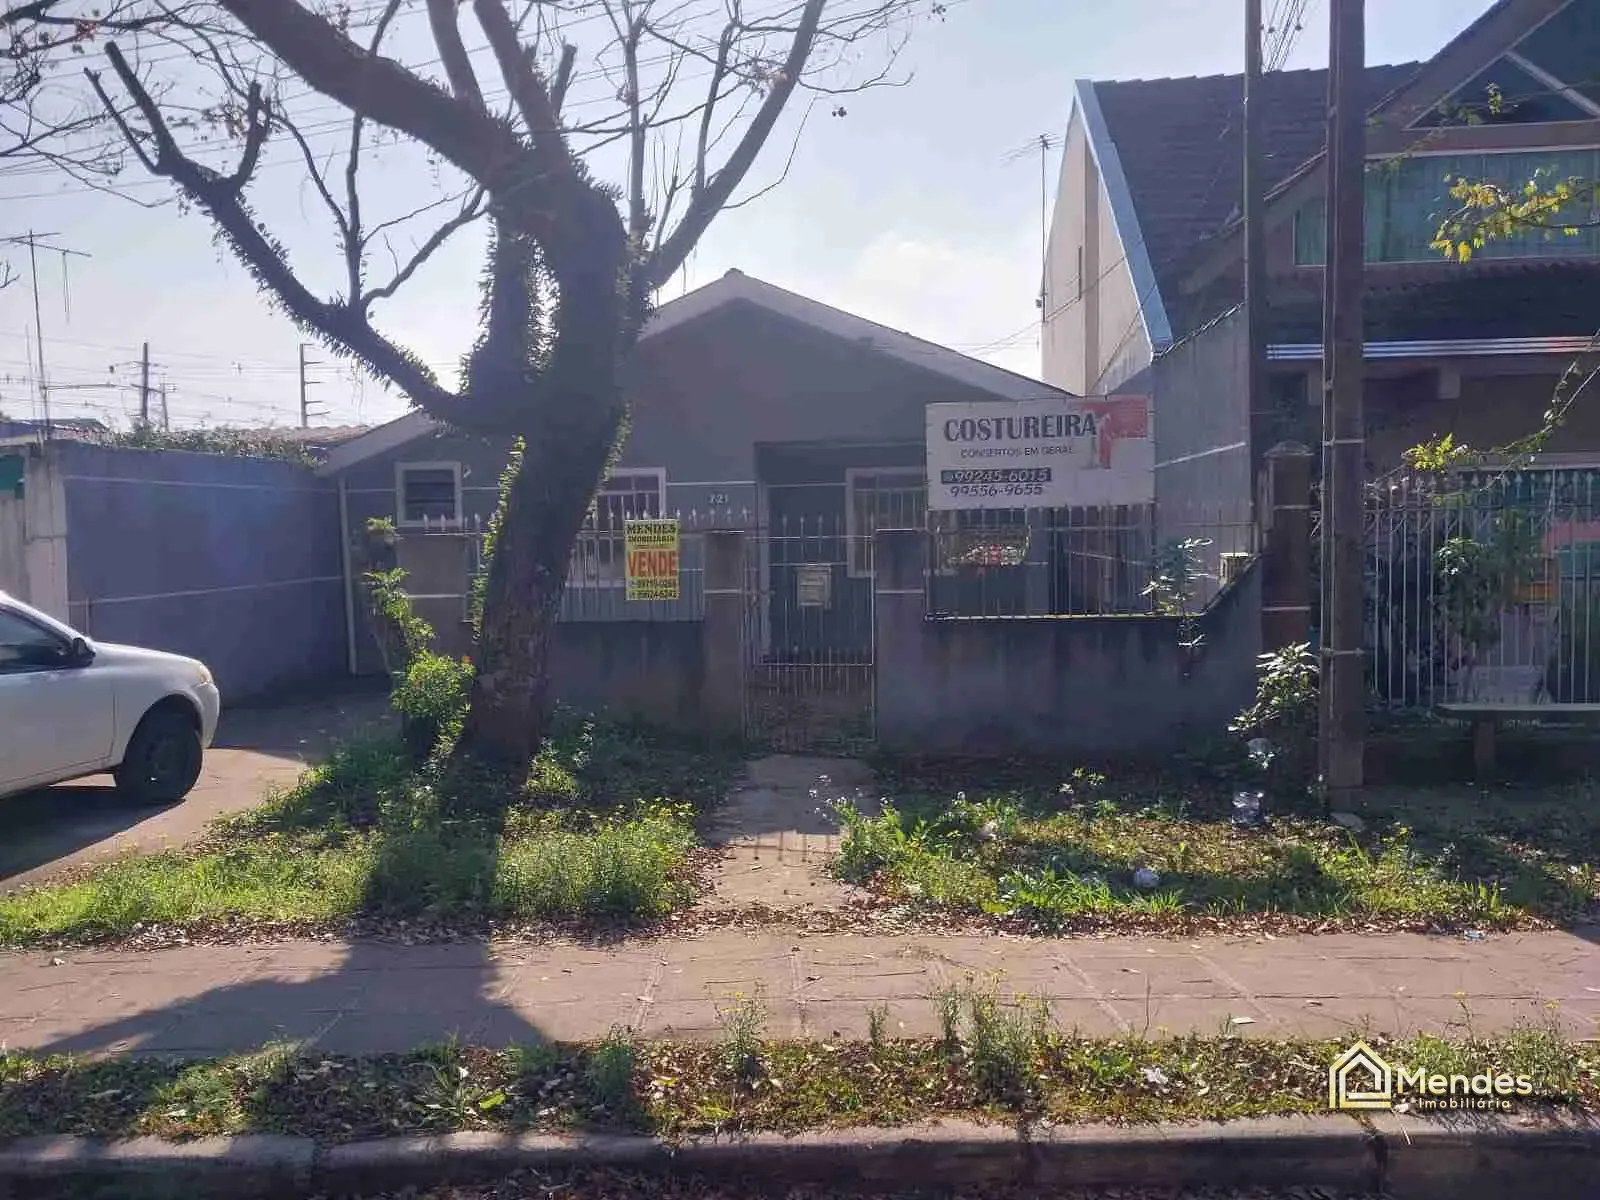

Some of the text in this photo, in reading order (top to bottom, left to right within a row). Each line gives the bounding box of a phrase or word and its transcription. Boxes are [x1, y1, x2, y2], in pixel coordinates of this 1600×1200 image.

[943, 412, 1097, 442] COSTUREIRA
[1024, 446, 1039, 456] EM
[1041, 445, 1074, 456] GERAL
[627, 523, 676, 534] MENDES
[627, 550, 678, 577] VENDE
